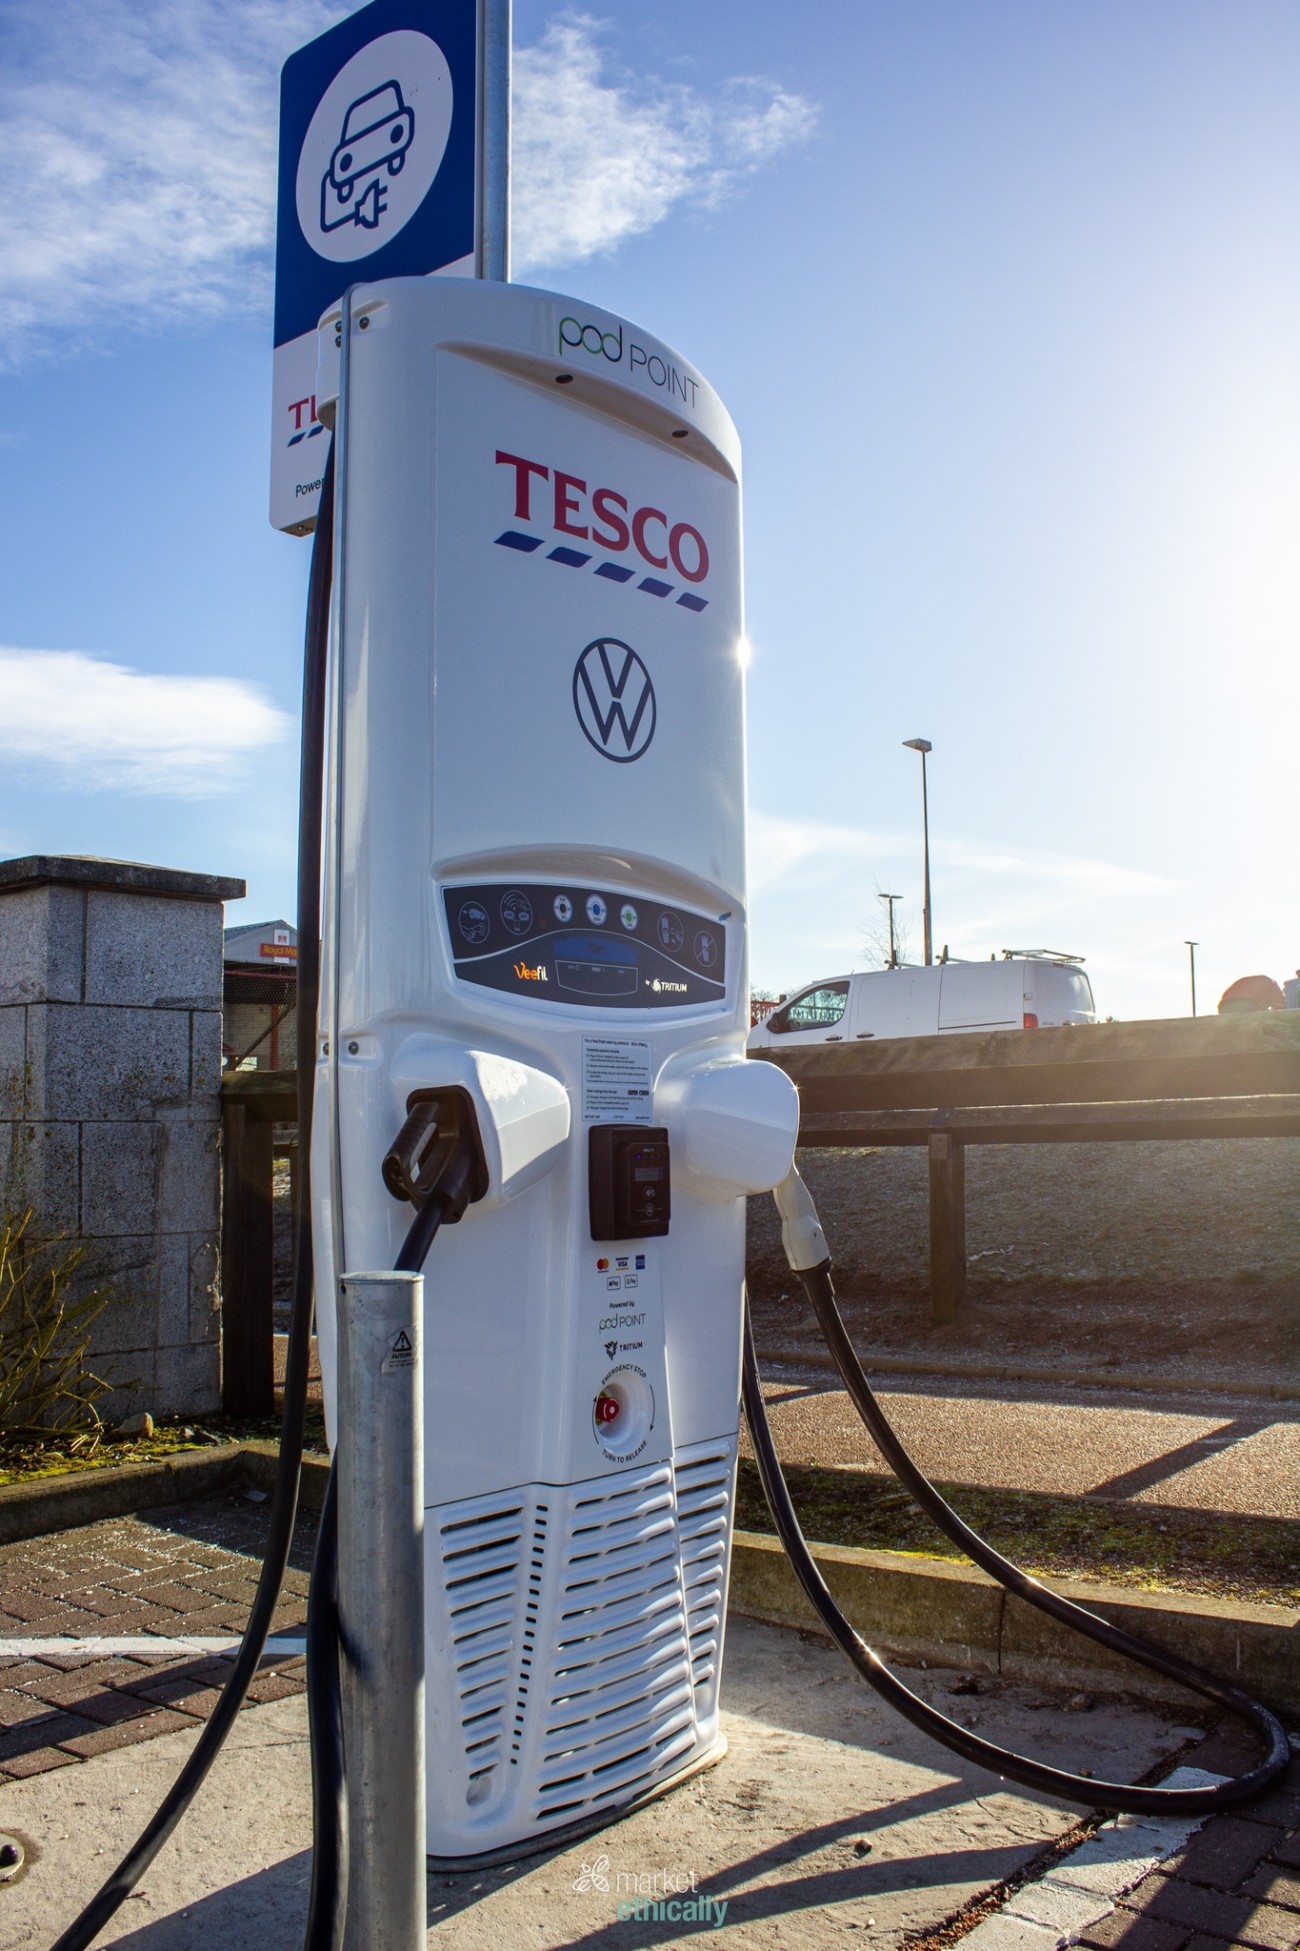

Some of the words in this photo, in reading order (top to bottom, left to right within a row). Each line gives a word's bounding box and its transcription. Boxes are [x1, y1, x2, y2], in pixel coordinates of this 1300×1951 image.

[559, 317, 622, 363] pod
[630, 343, 699, 408] POINT
[495, 449, 710, 583] TESCO
[264, 945, 284, 955] Royal
[660, 981, 688, 992] TRITIUM
[617, 1260, 628, 1268] VISA
[609, 1301, 628, 1309] Powered
[629, 1300, 635, 1308] by
[599, 1313, 618, 1335] pod
[619, 1313, 646, 1328] POINT
[619, 1341, 643, 1352] TRITIUM
[601, 1363, 634, 1385] EMERGENCY
[634, 1365, 647, 1378] STOP
[602, 1448, 616, 1462] TURN
[625, 1439, 647, 1461] RELEASE
